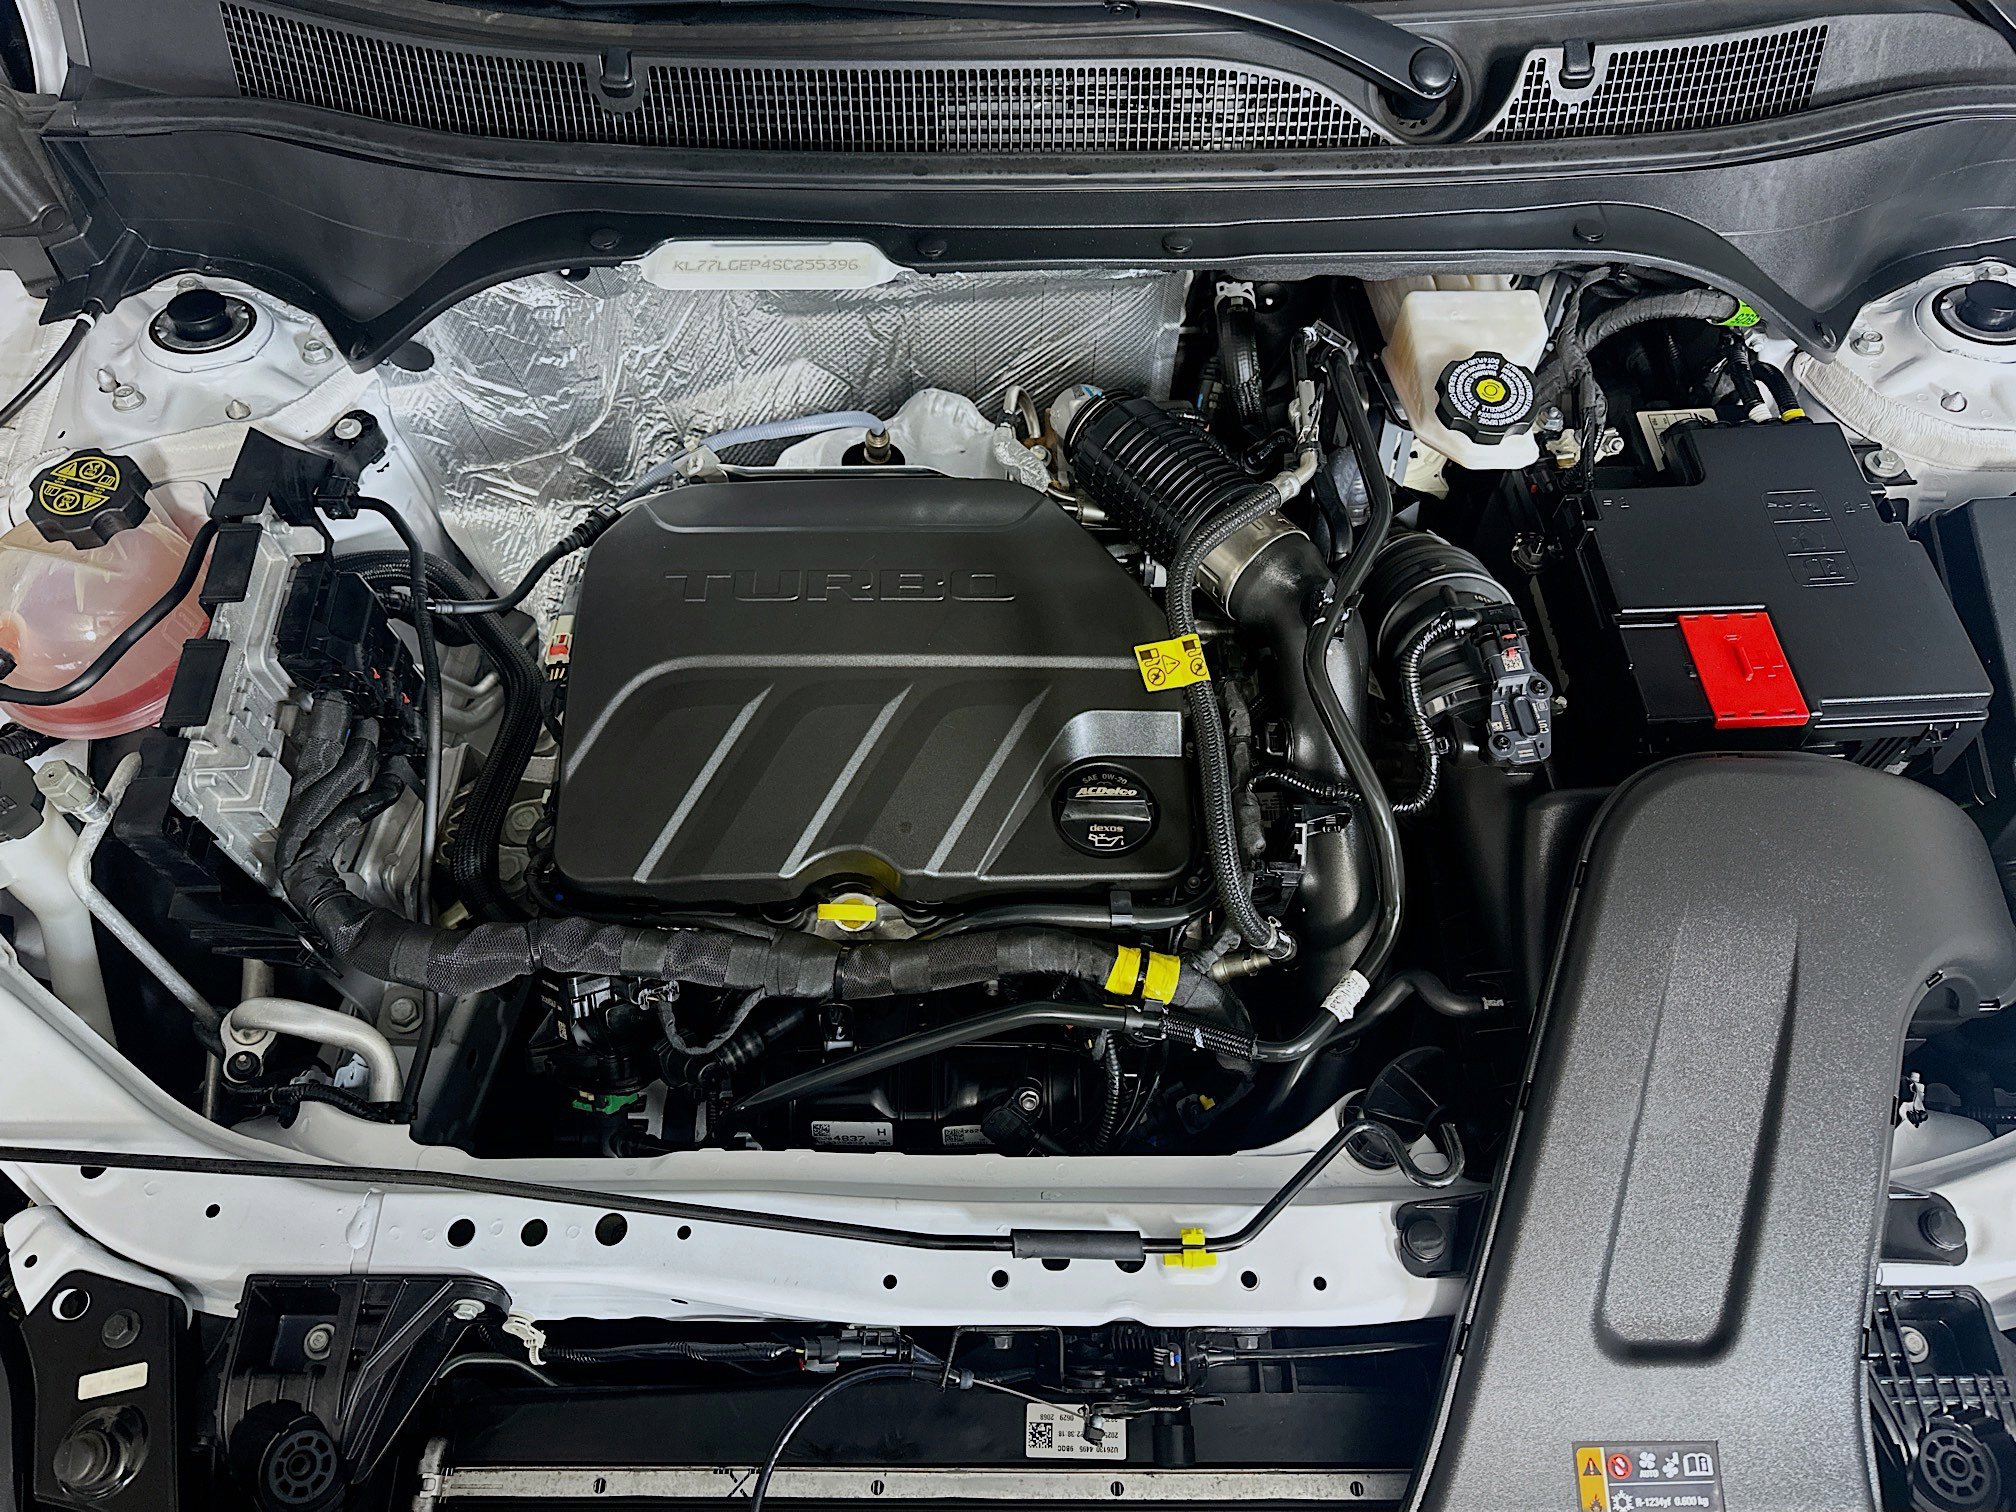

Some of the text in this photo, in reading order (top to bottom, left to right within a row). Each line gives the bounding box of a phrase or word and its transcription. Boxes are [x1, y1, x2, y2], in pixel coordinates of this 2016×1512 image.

[673, 259, 859, 271] KL77LGEP4SC255396
[664, 569, 1016, 602] TURBO
[1082, 773, 1128, 785] SAE 0W-20
[1074, 786, 1138, 798] ACDelco
[1089, 824, 1124, 833] dexos
[1635, 1496, 1671, 1508] R-1234yf
[1697, 1495, 1709, 1508] kg
